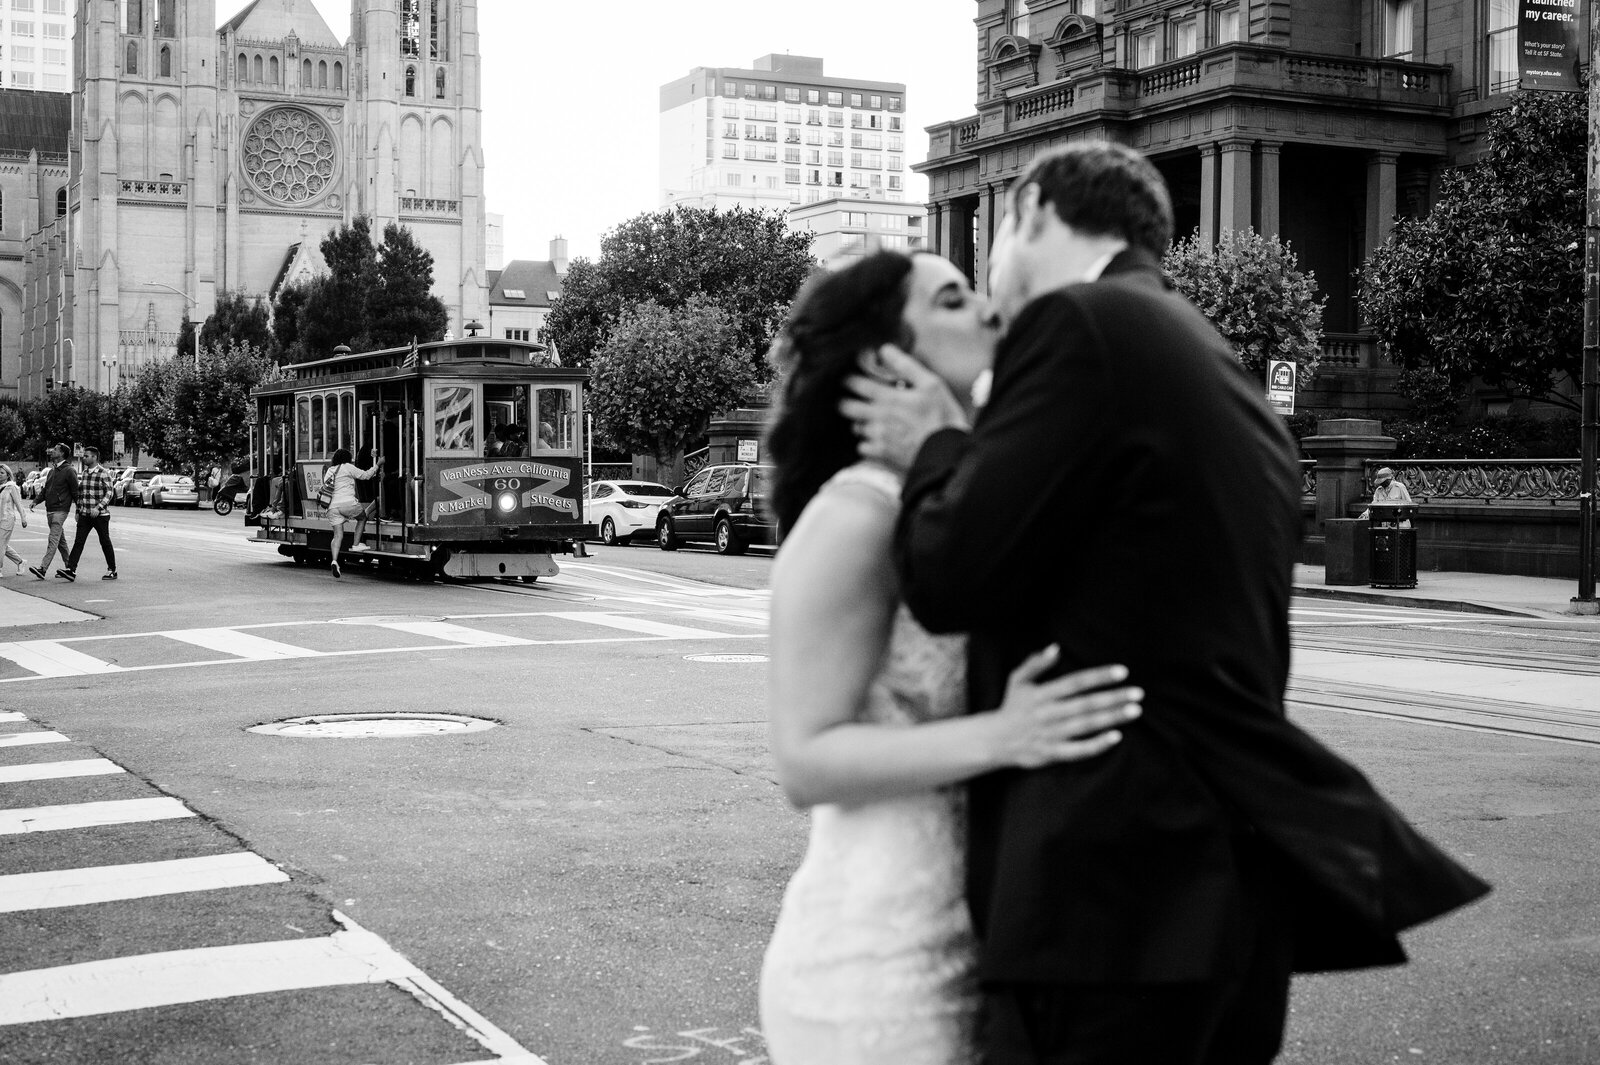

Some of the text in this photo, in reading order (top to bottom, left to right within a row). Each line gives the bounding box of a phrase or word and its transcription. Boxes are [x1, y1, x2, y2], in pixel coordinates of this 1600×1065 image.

[1525, 10, 1574, 22] my career.
[442, 471, 462, 481] Van
[462, 465, 489, 479] Ness
[519, 463, 569, 480] California
[494, 478, 521, 490] 60
[438, 496, 488, 513] & Market
[531, 494, 572, 509] Streets
